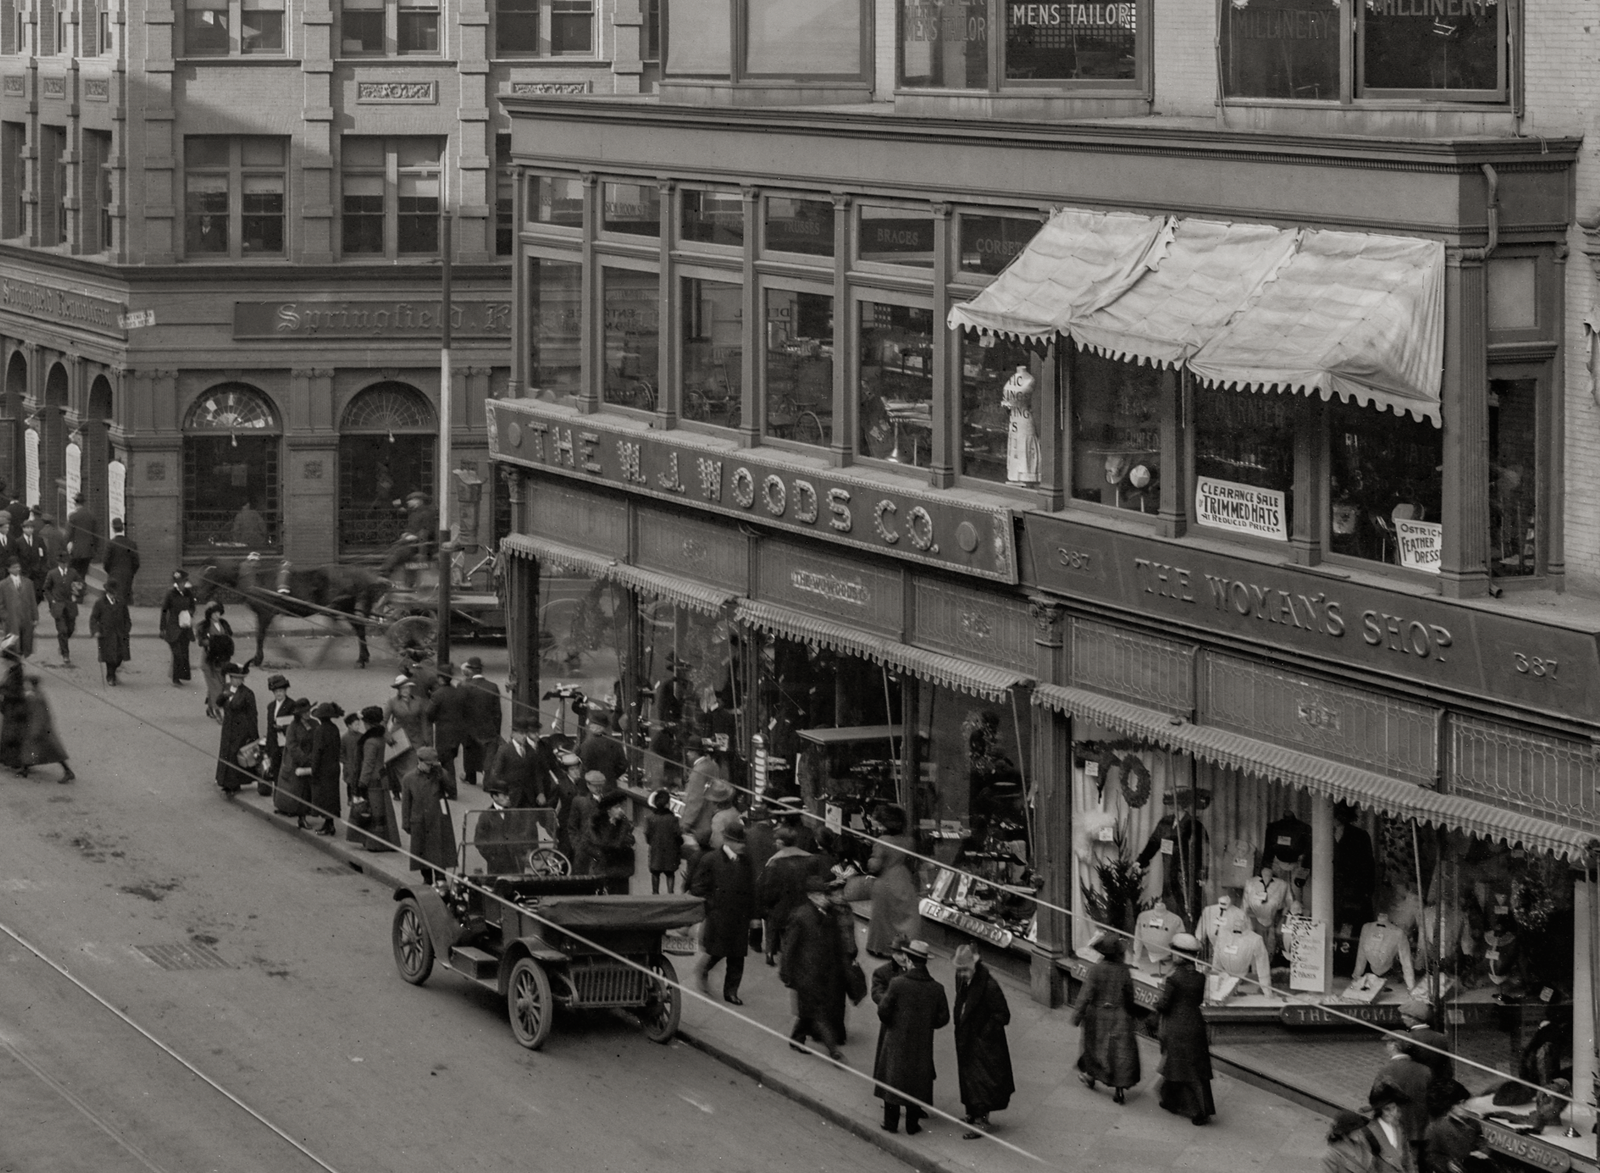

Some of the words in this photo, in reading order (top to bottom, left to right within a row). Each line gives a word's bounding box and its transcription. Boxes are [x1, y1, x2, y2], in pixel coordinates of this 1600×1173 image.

[1013, 4, 1060, 25] MENS
[1067, 3, 1131, 28] TAILOR
[1234, 10, 1331, 39] MILLINERY
[877, 228, 919, 246] BRACES
[528, 421, 602, 473] THE
[697, 457, 852, 532] WOODS
[1200, 482, 1255, 502] CLEARANCE
[1256, 492, 1279, 508] SALE
[1203, 494, 1250, 521] TRIMMED
[1251, 505, 1280, 527] HATS
[1211, 514, 1248, 527] REDUCED
[1248, 522, 1277, 534] PRICES
[1058, 547, 1092, 572] 387
[1401, 536, 1435, 562] FEATHER
[1135, 558, 1197, 604] THE
[1204, 574, 1346, 638] WOMAN'S
[1362, 609, 1454, 663] SHOP
[1513, 652, 1558, 681] 387
[1298, 1009, 1331, 1022] THE
